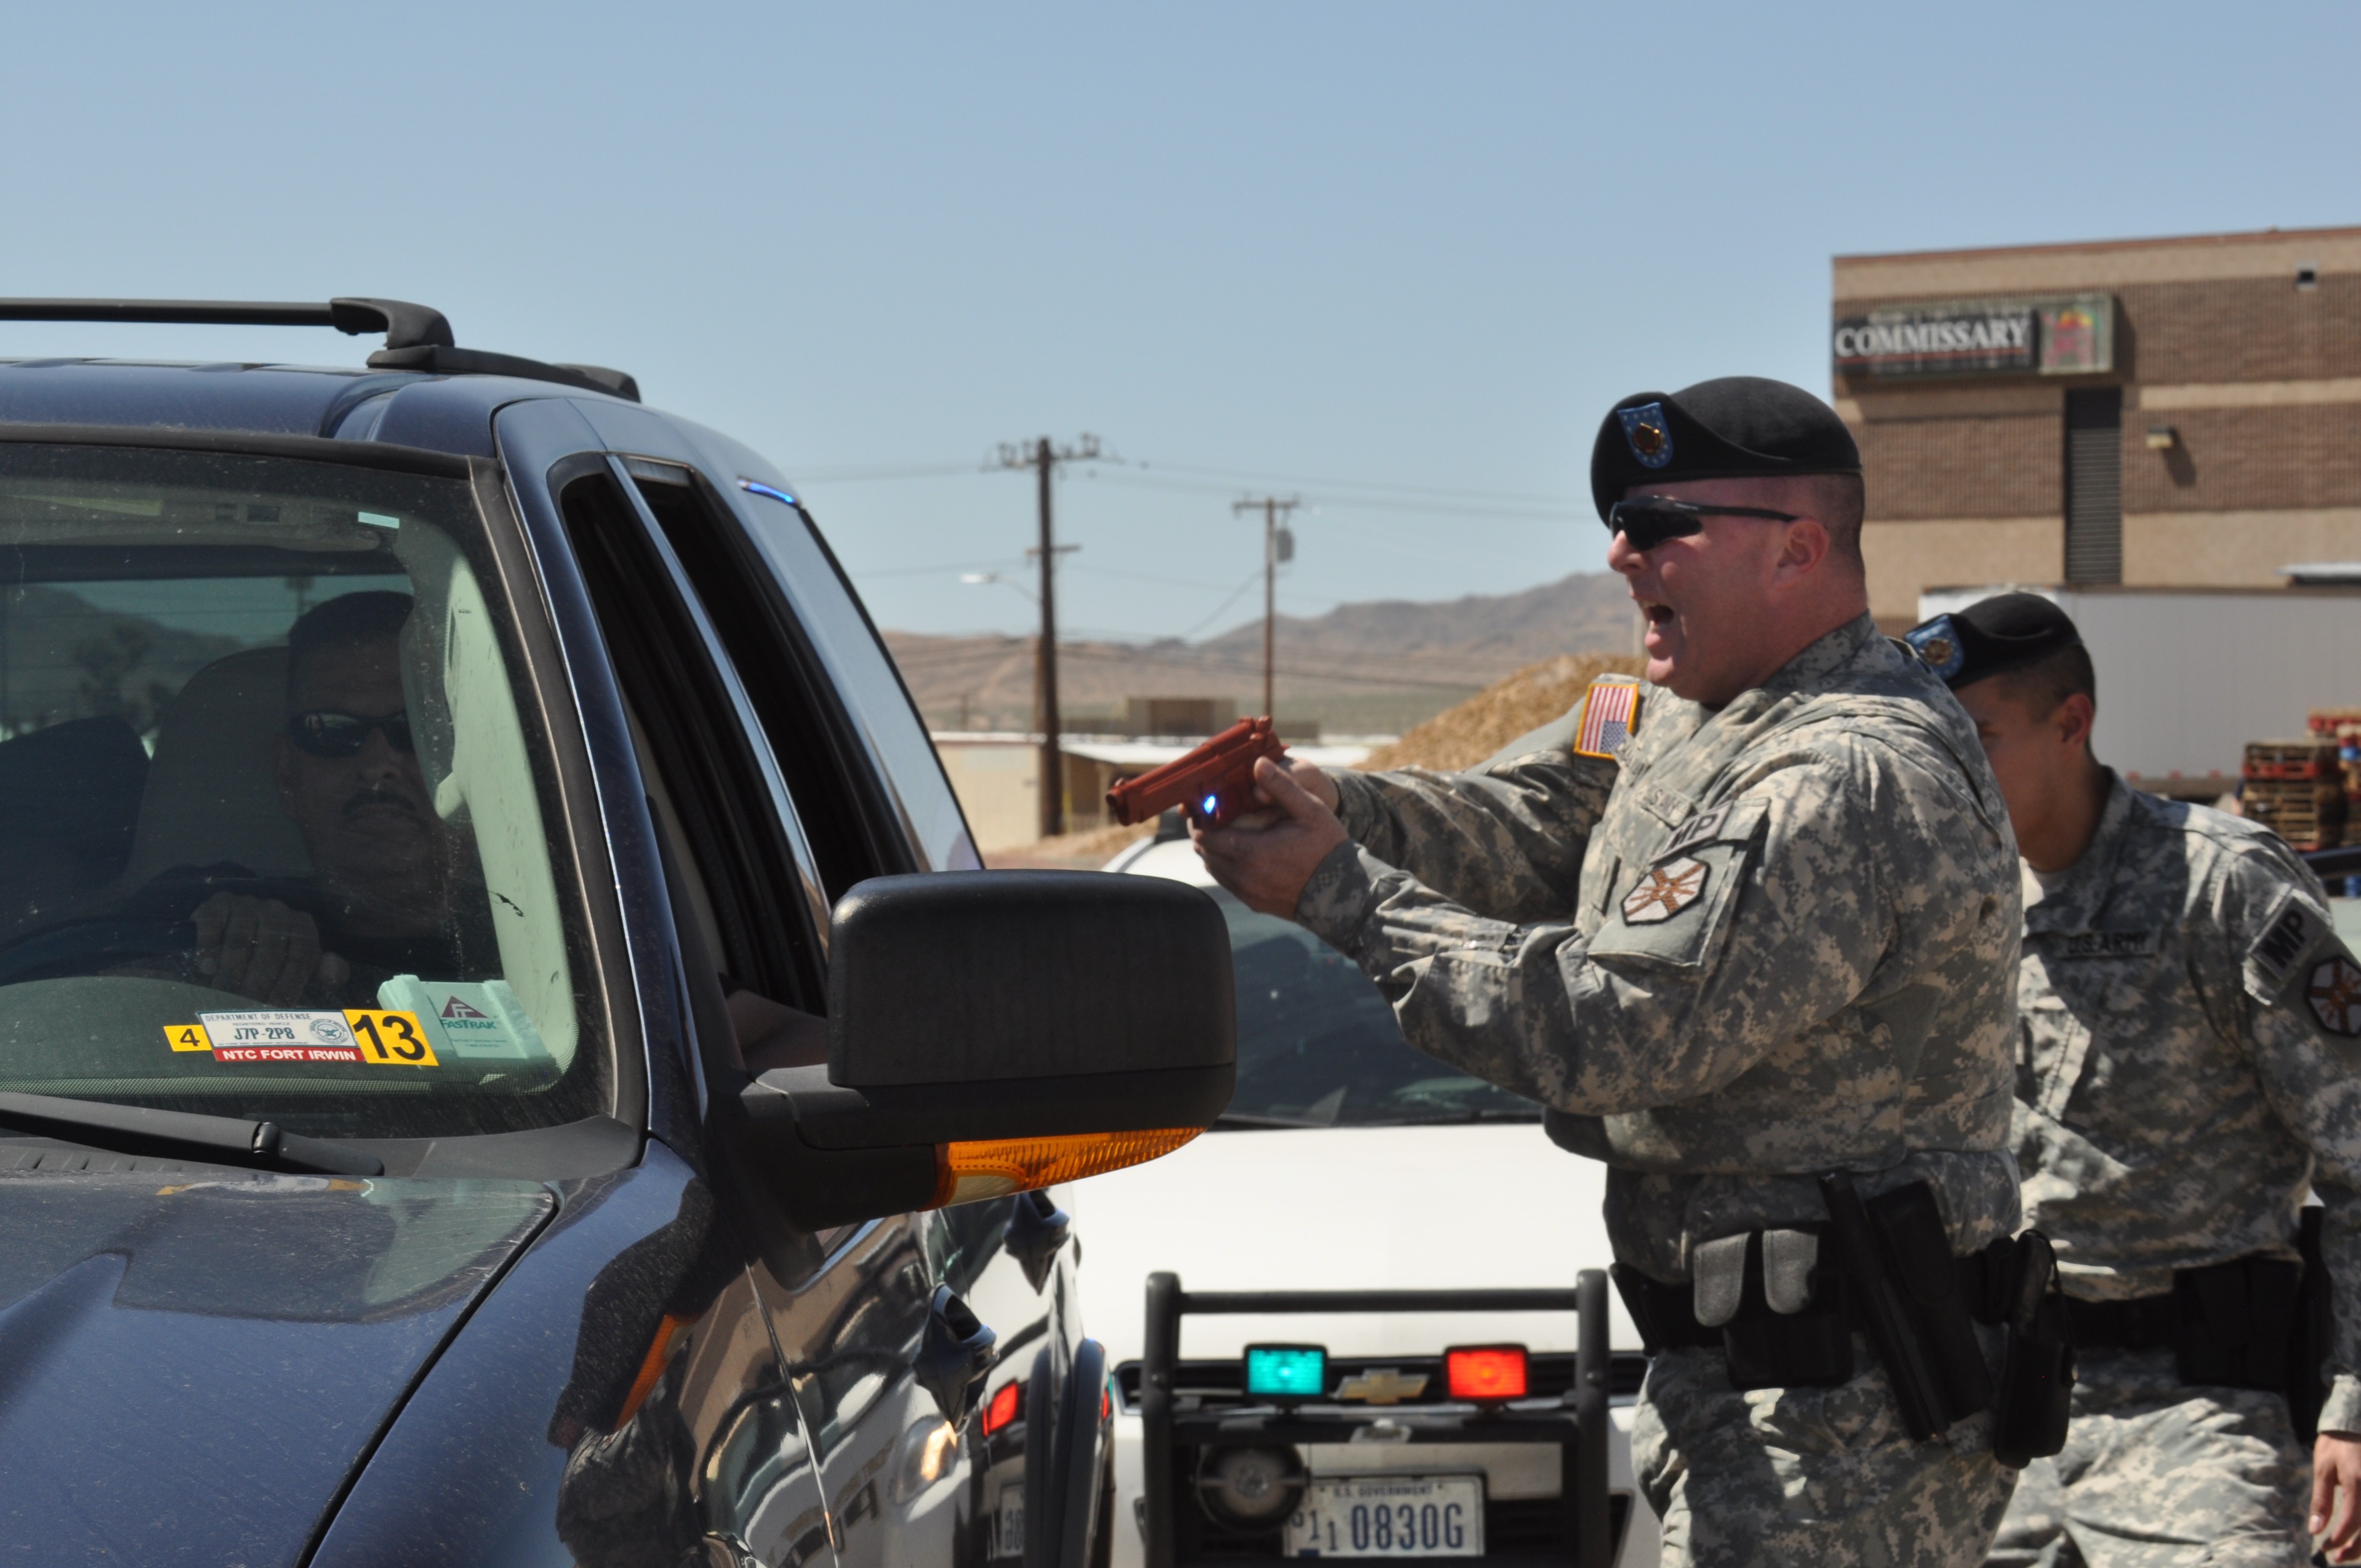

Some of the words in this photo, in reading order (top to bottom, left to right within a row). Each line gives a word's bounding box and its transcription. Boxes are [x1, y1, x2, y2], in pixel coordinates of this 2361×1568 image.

[1835, 317, 2028, 356] COMMISSARY
[1667, 813, 1718, 850] MP
[2262, 910, 2306, 969] MP
[179, 1028, 200, 1046] 4
[234, 1027, 296, 1040] J7P-2P8
[351, 1014, 426, 1061] 13
[222, 1049, 258, 1060] NTC
[259, 1049, 304, 1060] FORT
[308, 1050, 357, 1061] IRWIN
[1352, 1502, 1464, 1551] 0830G
